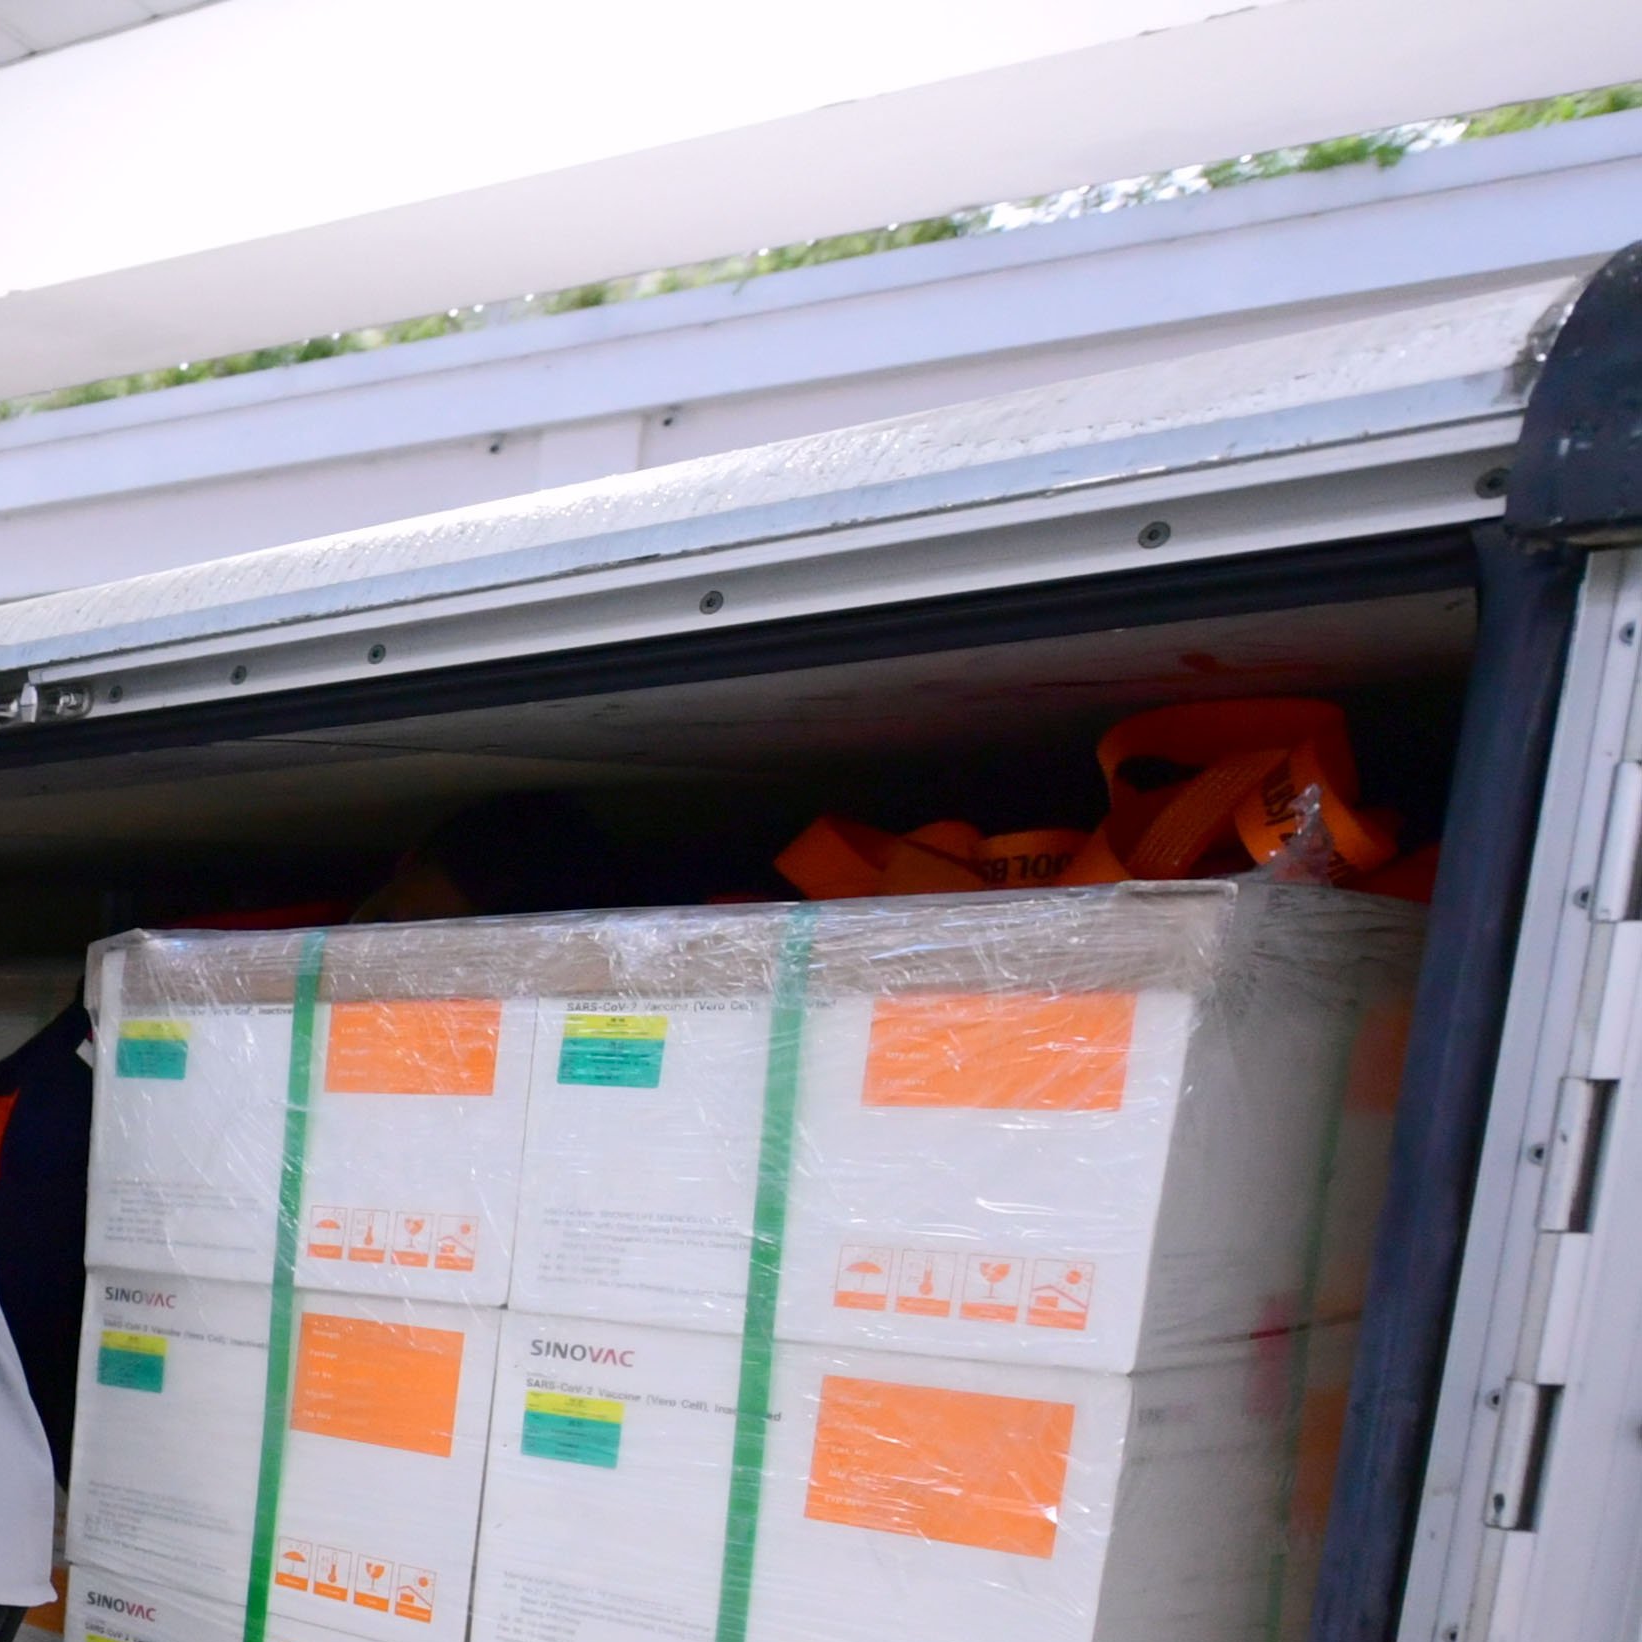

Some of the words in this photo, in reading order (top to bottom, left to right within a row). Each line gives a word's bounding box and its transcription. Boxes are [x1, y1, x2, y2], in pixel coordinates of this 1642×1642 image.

[103, 1286, 176, 1309] SINOVAC
[530, 1339, 635, 1367] SINOVAC
[526, 1377, 593, 1396] SARS-CoV-2
[598, 1386, 641, 1401] Vaccine
[646, 1393, 676, 1407] (Vero
[86, 1591, 157, 1622] SINOVAC
